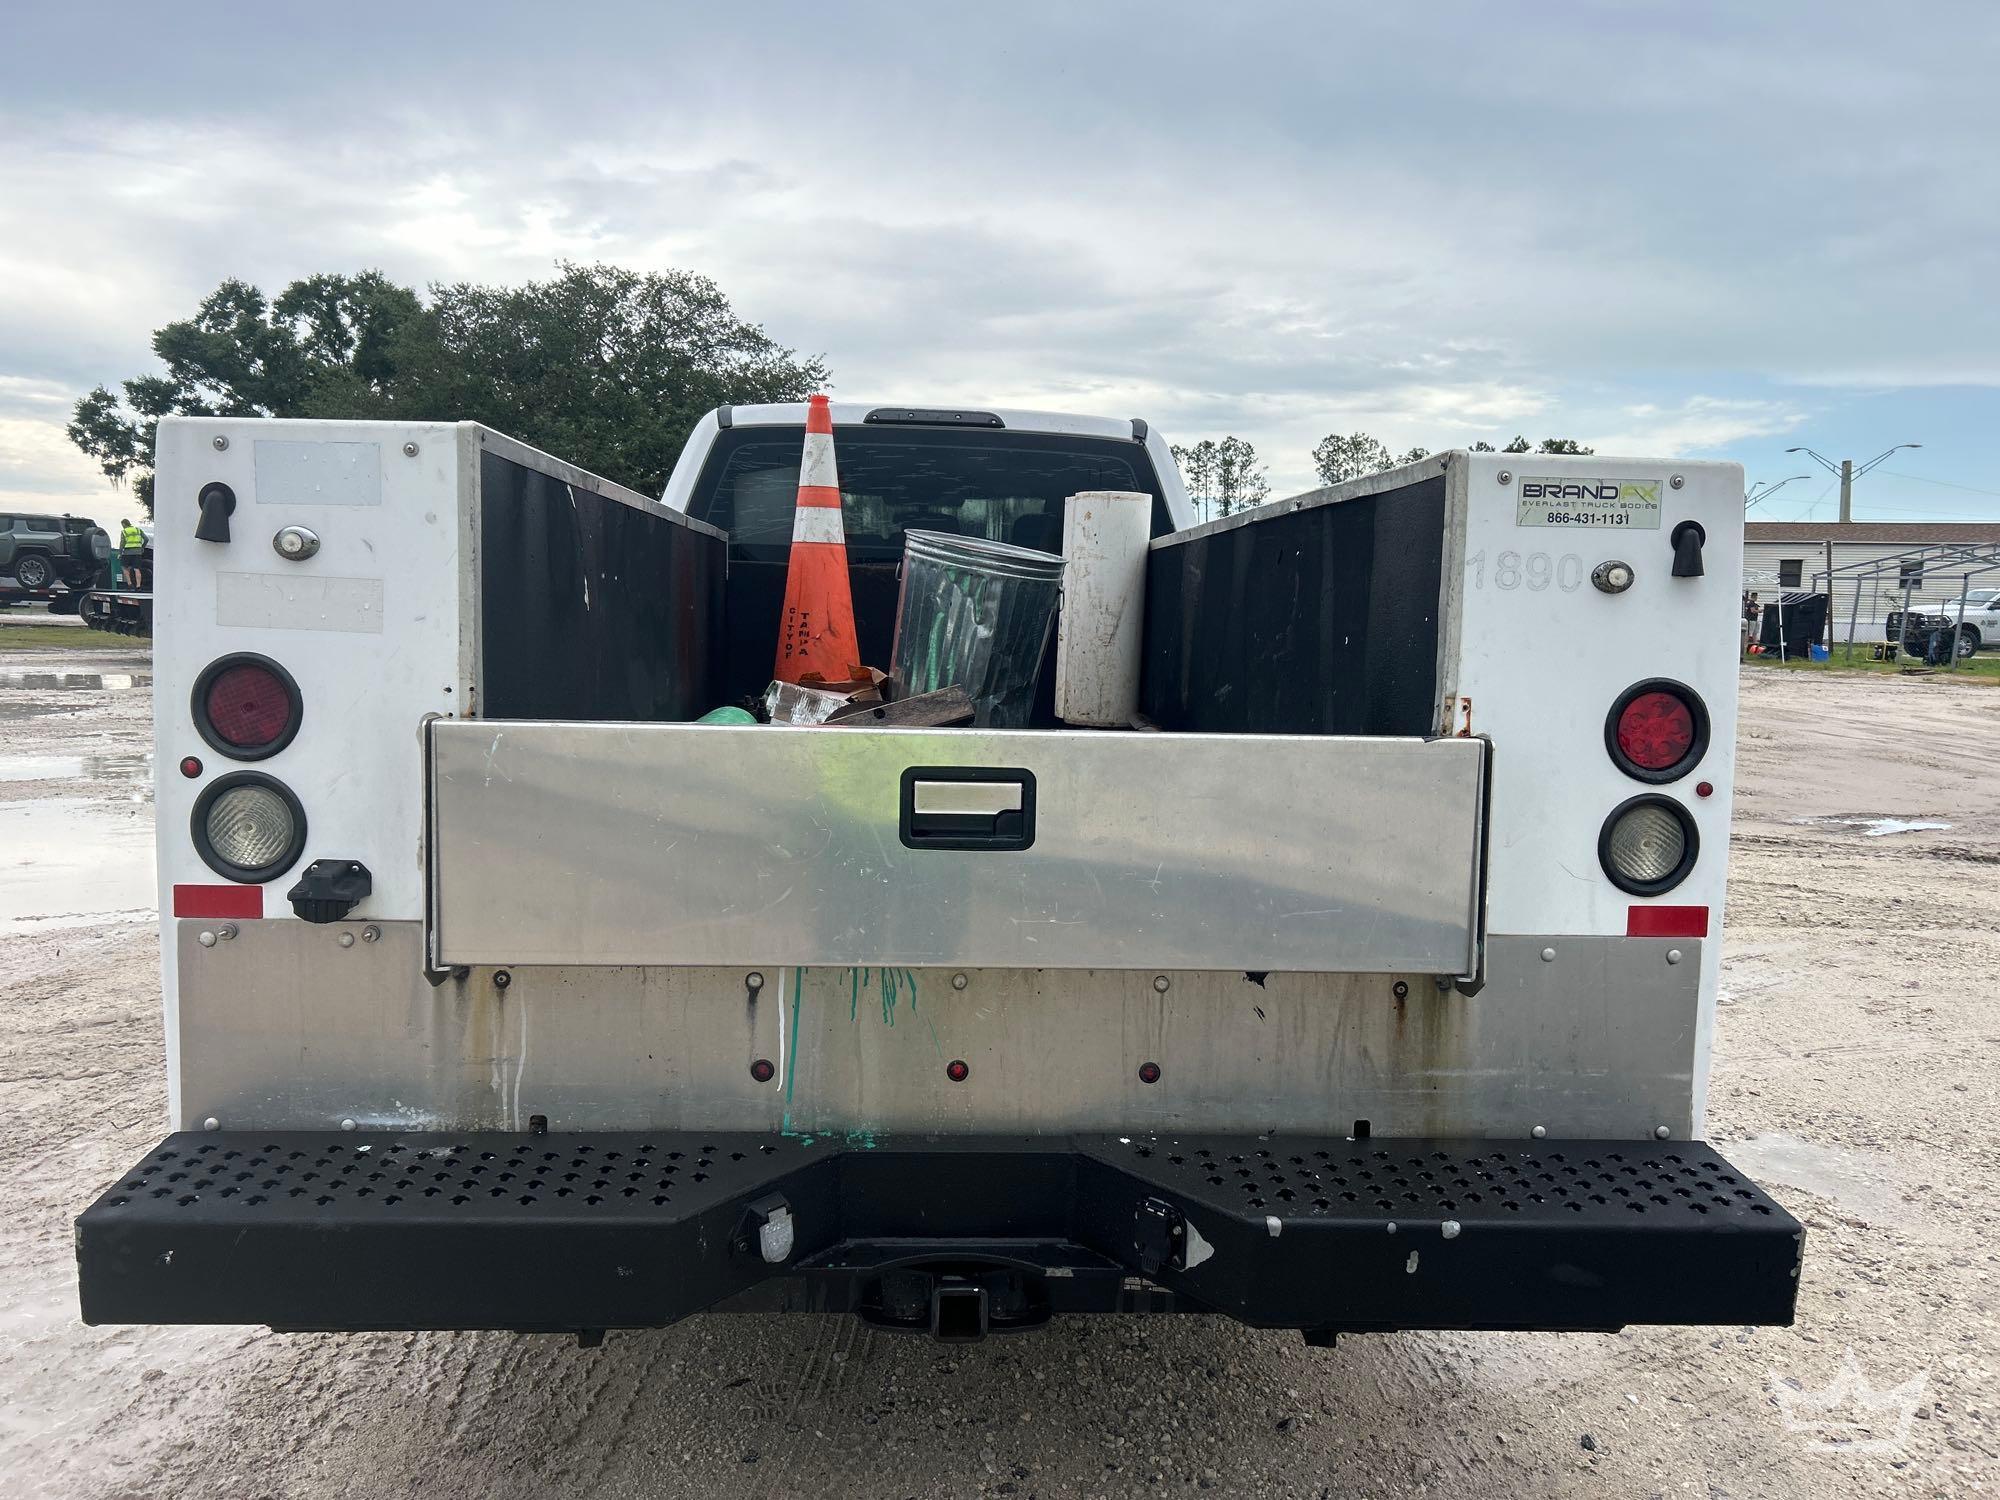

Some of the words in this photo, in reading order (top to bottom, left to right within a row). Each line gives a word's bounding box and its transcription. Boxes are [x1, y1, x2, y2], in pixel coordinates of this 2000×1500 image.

[1522, 500, 1577, 508] EVERLAST
[1547, 512, 1630, 525] 866-431-1131
[1466, 550, 1583, 592] 1890
[799, 613, 809, 656] TAMPA
